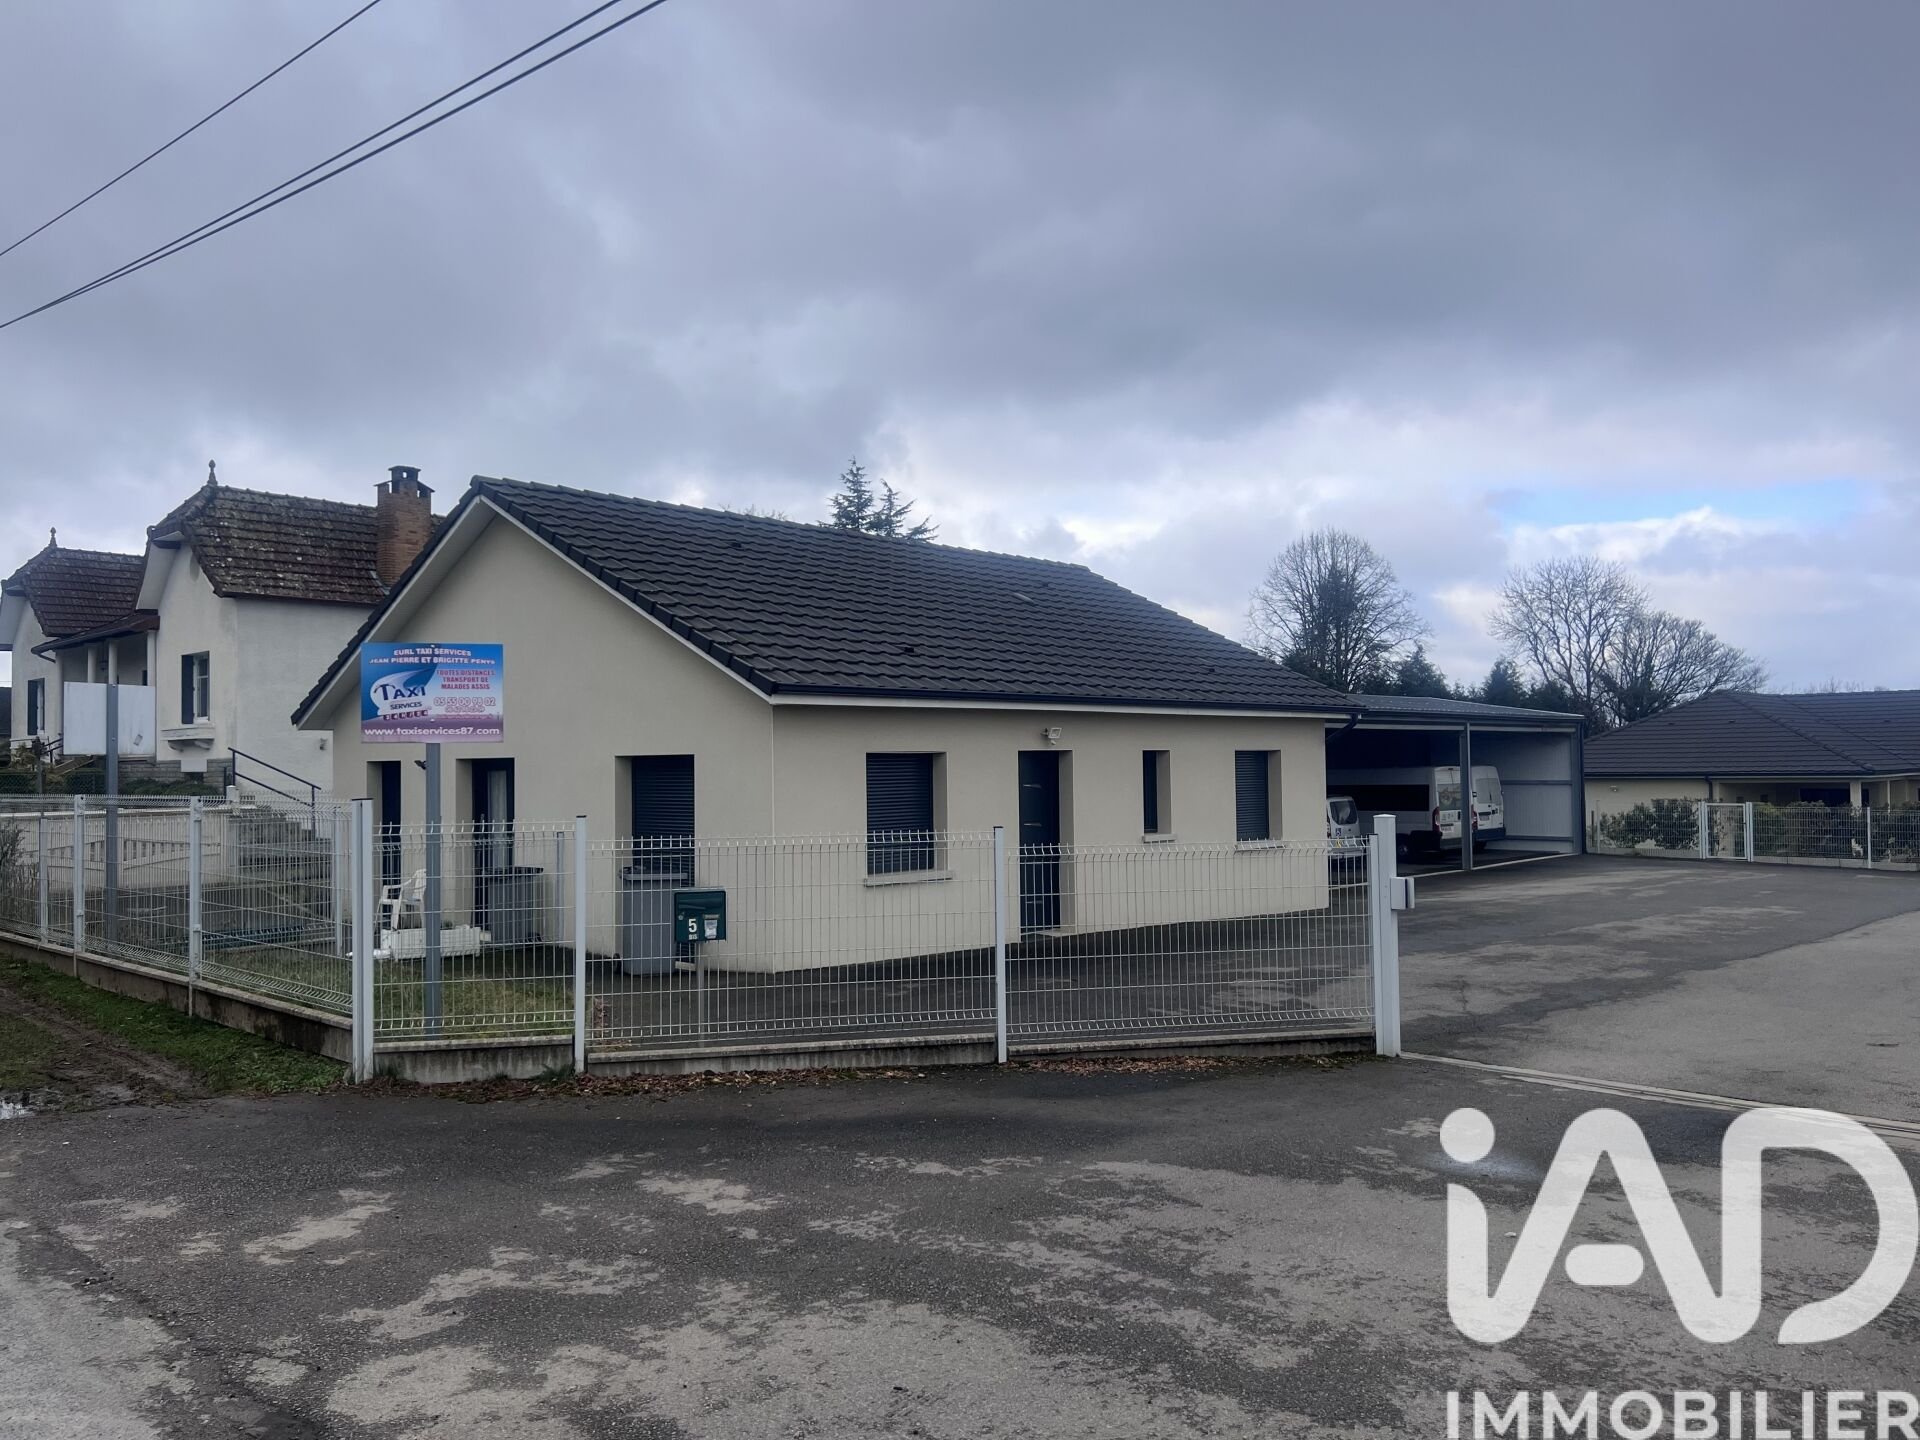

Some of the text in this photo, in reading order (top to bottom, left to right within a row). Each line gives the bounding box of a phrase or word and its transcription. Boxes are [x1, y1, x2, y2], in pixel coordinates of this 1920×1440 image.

[434, 648, 472, 657] SERVICES
[421, 656, 431, 664] ET
[433, 656, 469, 664] BRIGITTE
[373, 683, 426, 701] TAXI
[390, 702, 423, 710] SERVICES
[433, 697, 446, 706] 05
[446, 697, 458, 706] 55
[484, 697, 497, 706] 02
[364, 727, 500, 735] www.taxiservices87.com
[688, 918, 697, 932] 5
